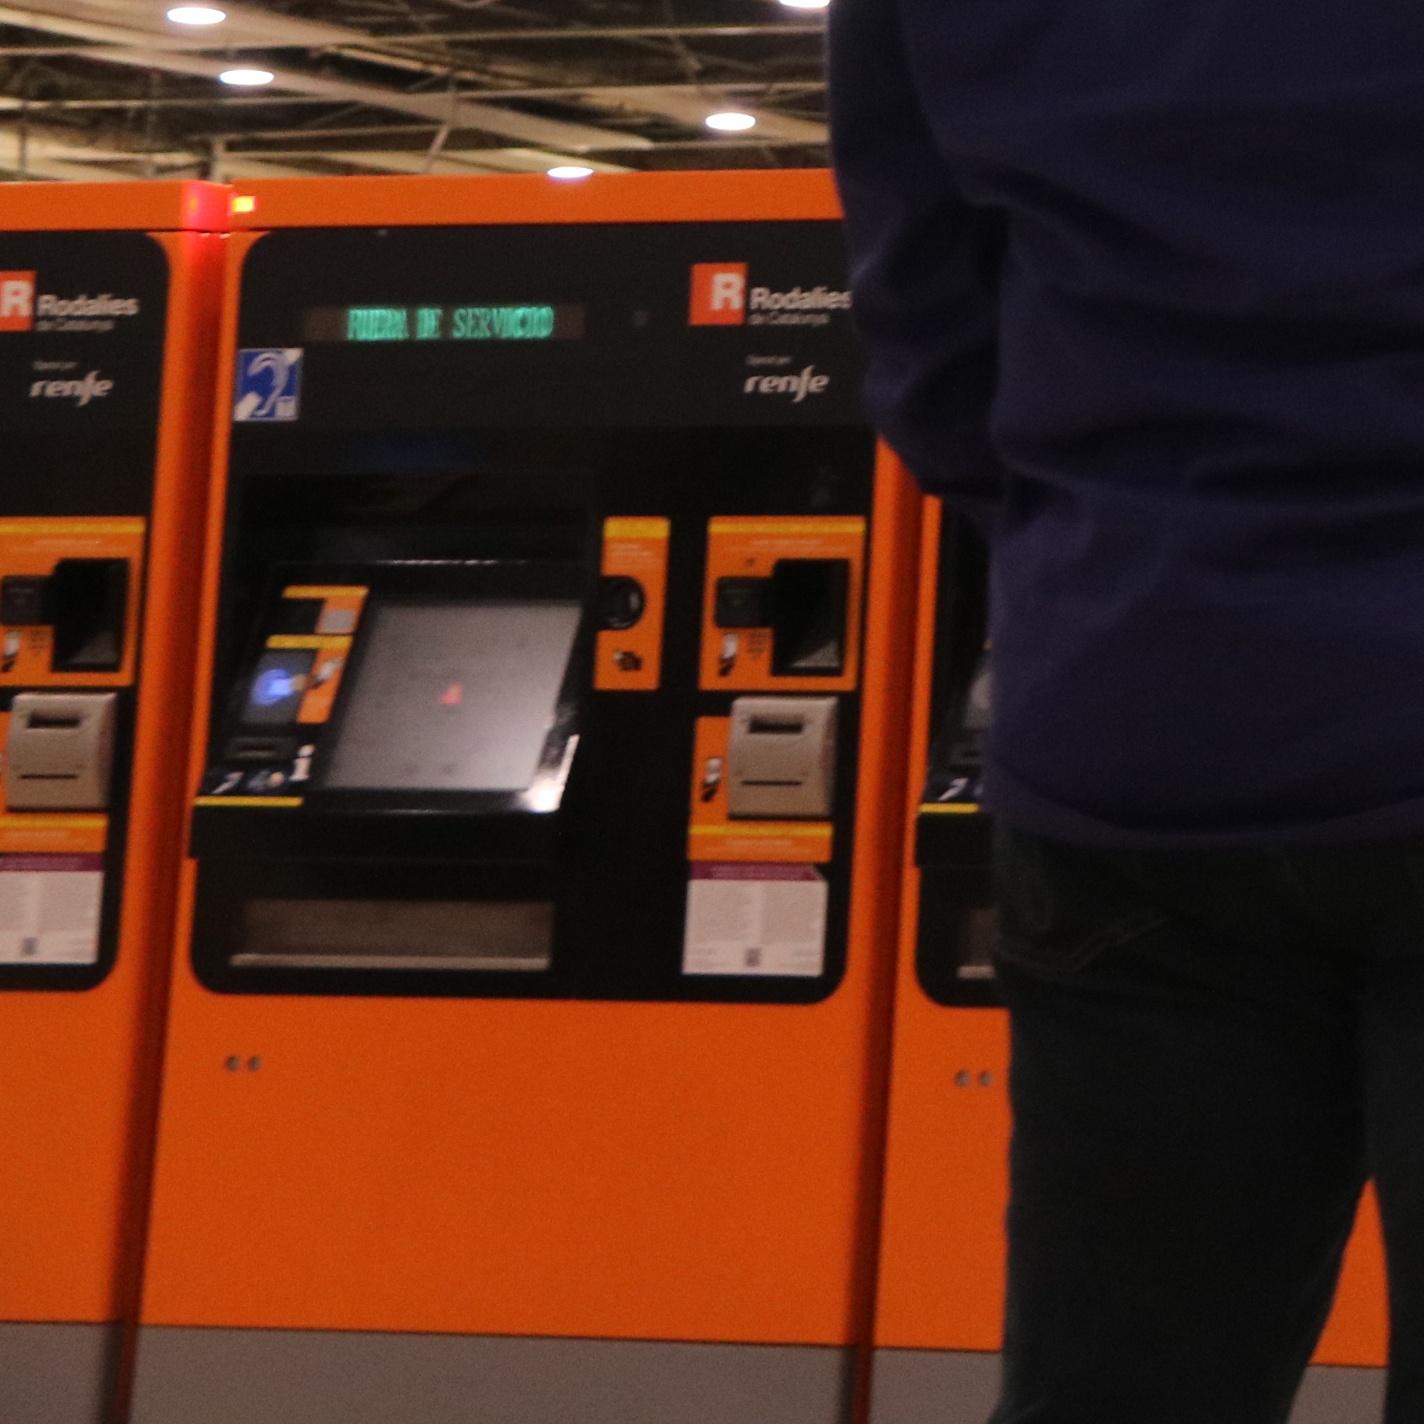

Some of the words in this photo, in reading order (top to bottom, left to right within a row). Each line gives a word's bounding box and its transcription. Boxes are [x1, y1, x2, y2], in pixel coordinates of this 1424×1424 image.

[2, 280, 33, 317] R
[37, 293, 139, 317] Rodalies
[711, 273, 744, 310] R
[749, 288, 851, 311] Rodalies
[29, 371, 114, 407] renfe
[743, 365, 830, 403] renfe
